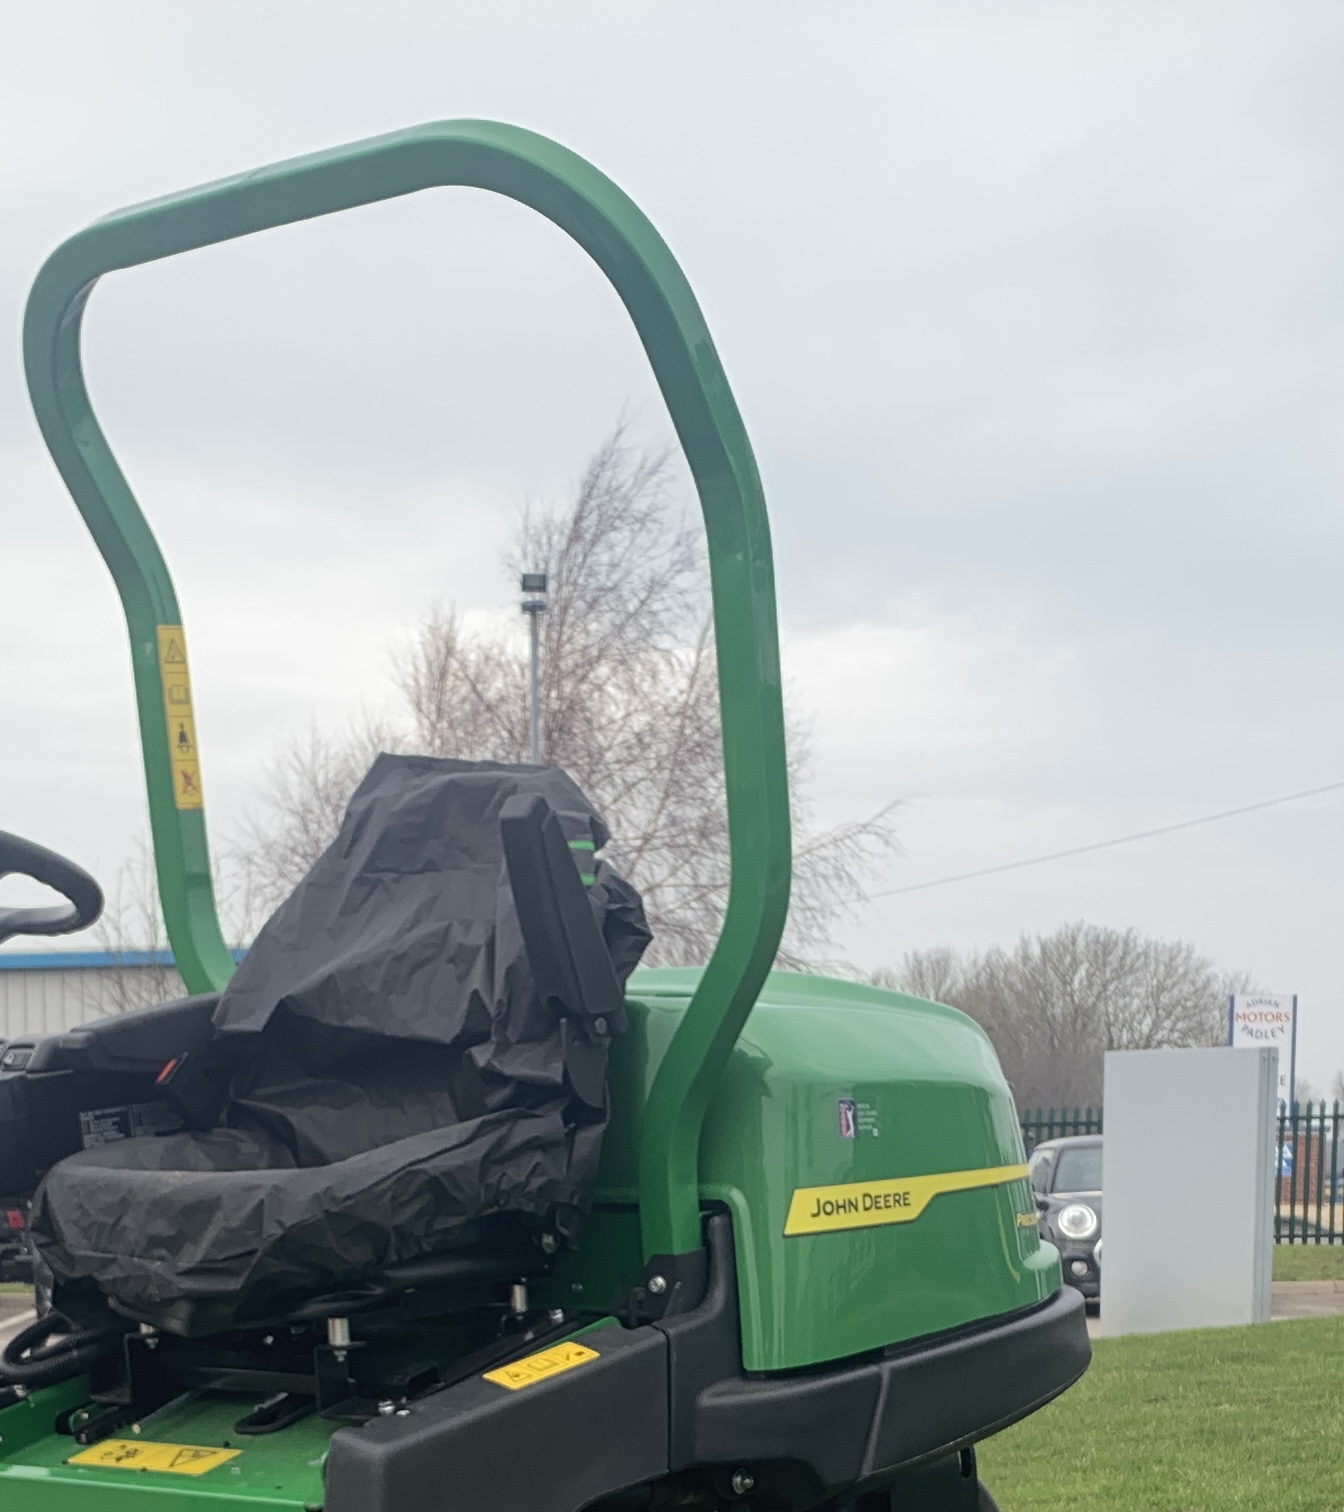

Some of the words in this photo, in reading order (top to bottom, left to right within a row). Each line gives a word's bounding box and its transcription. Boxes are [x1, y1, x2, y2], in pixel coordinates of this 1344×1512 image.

[1246, 997, 1281, 1009] ADRIAN
[1235, 1011, 1291, 1023] MOTORS
[1240, 1023, 1285, 1040] PADLEY
[810, 1197, 859, 1218] JOHN
[862, 1191, 911, 1211] DEERE
